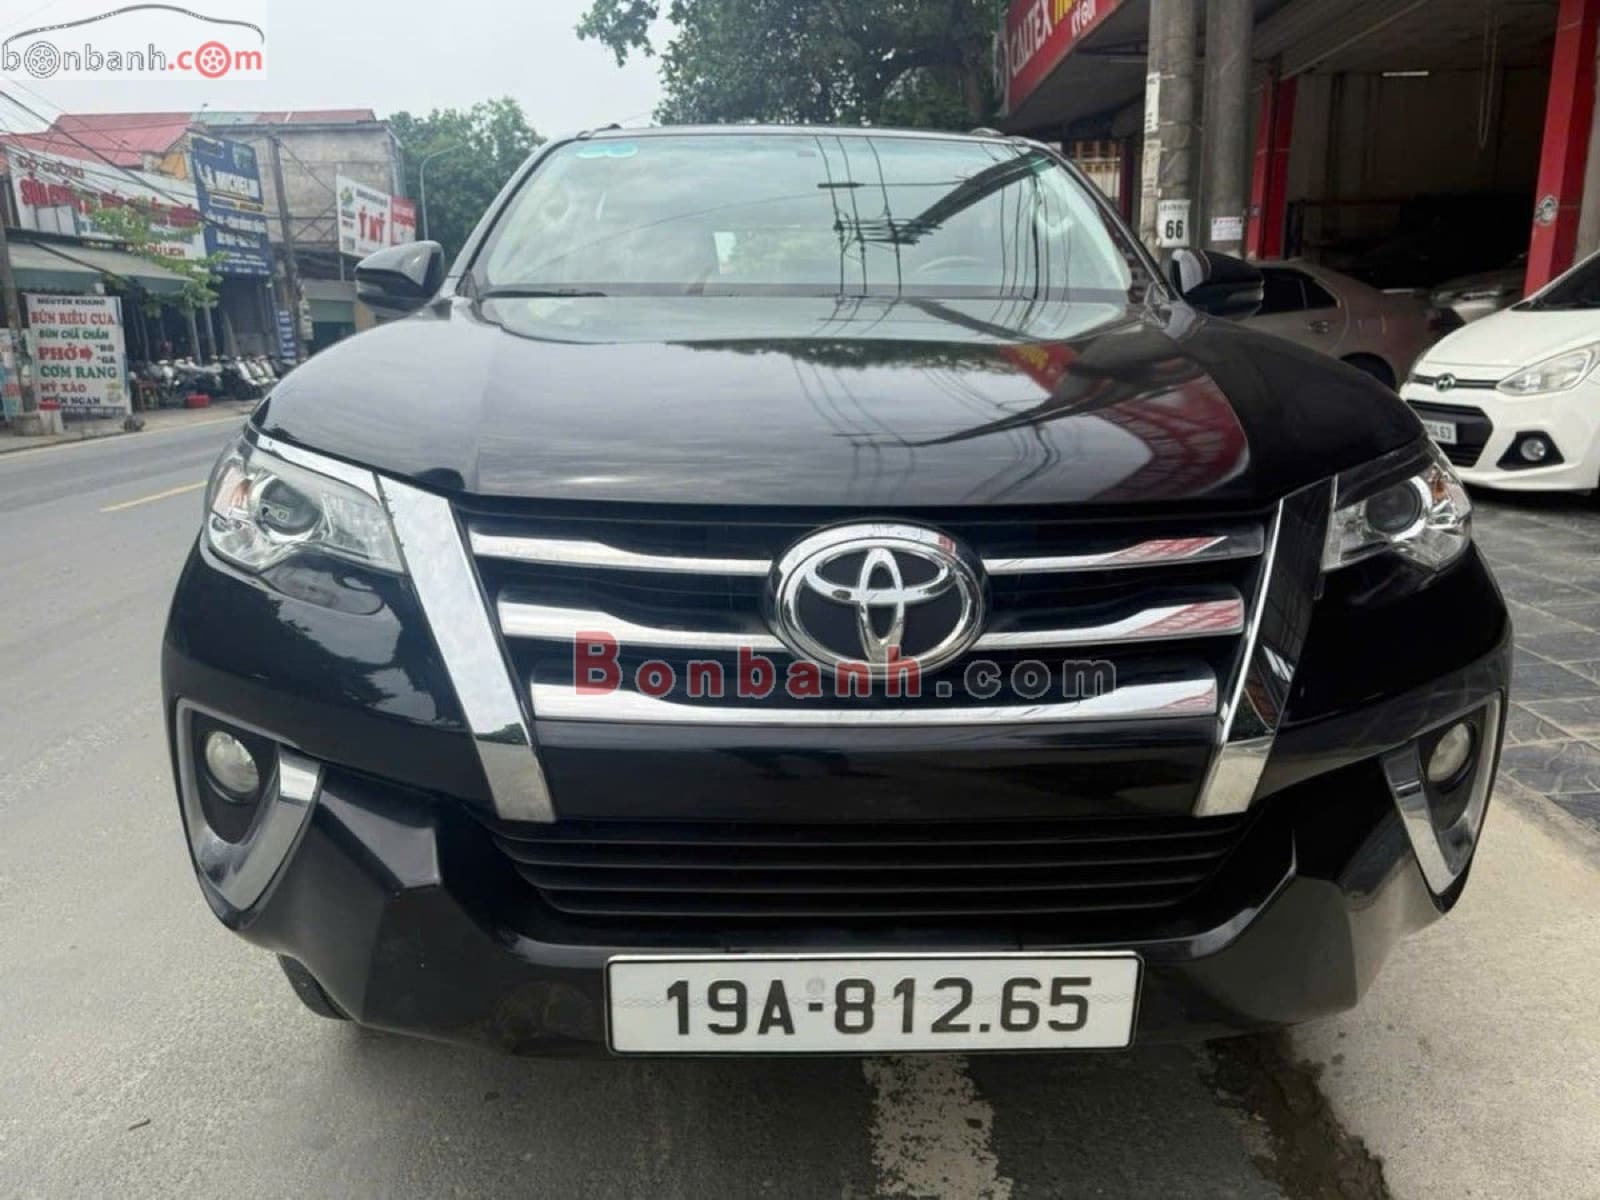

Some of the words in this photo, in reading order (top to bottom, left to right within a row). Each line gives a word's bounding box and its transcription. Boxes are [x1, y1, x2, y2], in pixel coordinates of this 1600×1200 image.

[31, 308, 57, 324] BÚN
[90, 313, 115, 325] CUA
[38, 342, 78, 361] PHỞ
[40, 364, 72, 378] CƠM
[75, 367, 117, 378] RANG
[666, 977, 1092, 1036] 19A-812.65
